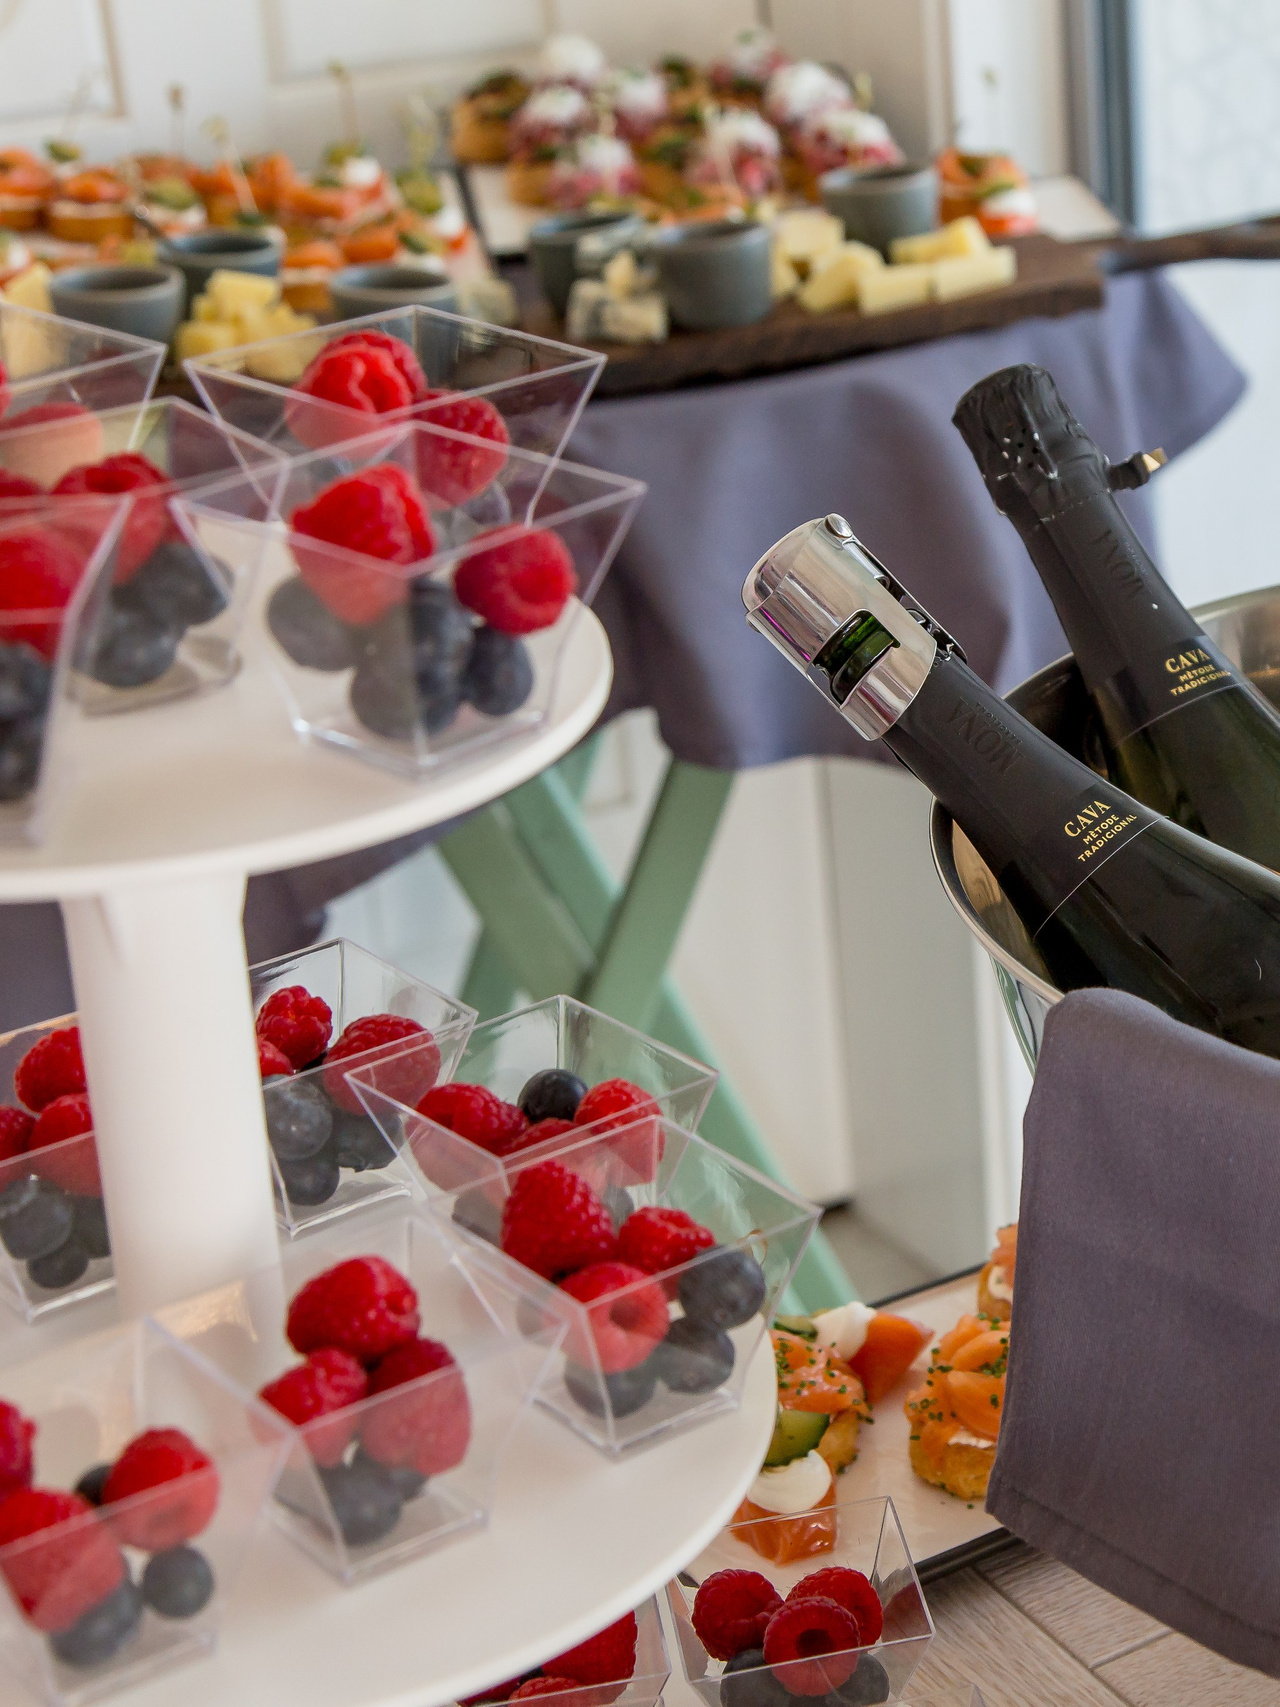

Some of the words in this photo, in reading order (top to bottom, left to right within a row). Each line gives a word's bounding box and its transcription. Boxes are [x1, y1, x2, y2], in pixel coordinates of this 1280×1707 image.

[1165, 648, 1211, 674] CAVA
[1171, 670, 1232, 698] TRADICIONAL
[1063, 800, 1112, 839] CAVA
[1082, 814, 1120, 846] MÈTODE
[1077, 813, 1138, 863] TRADICIONAL
